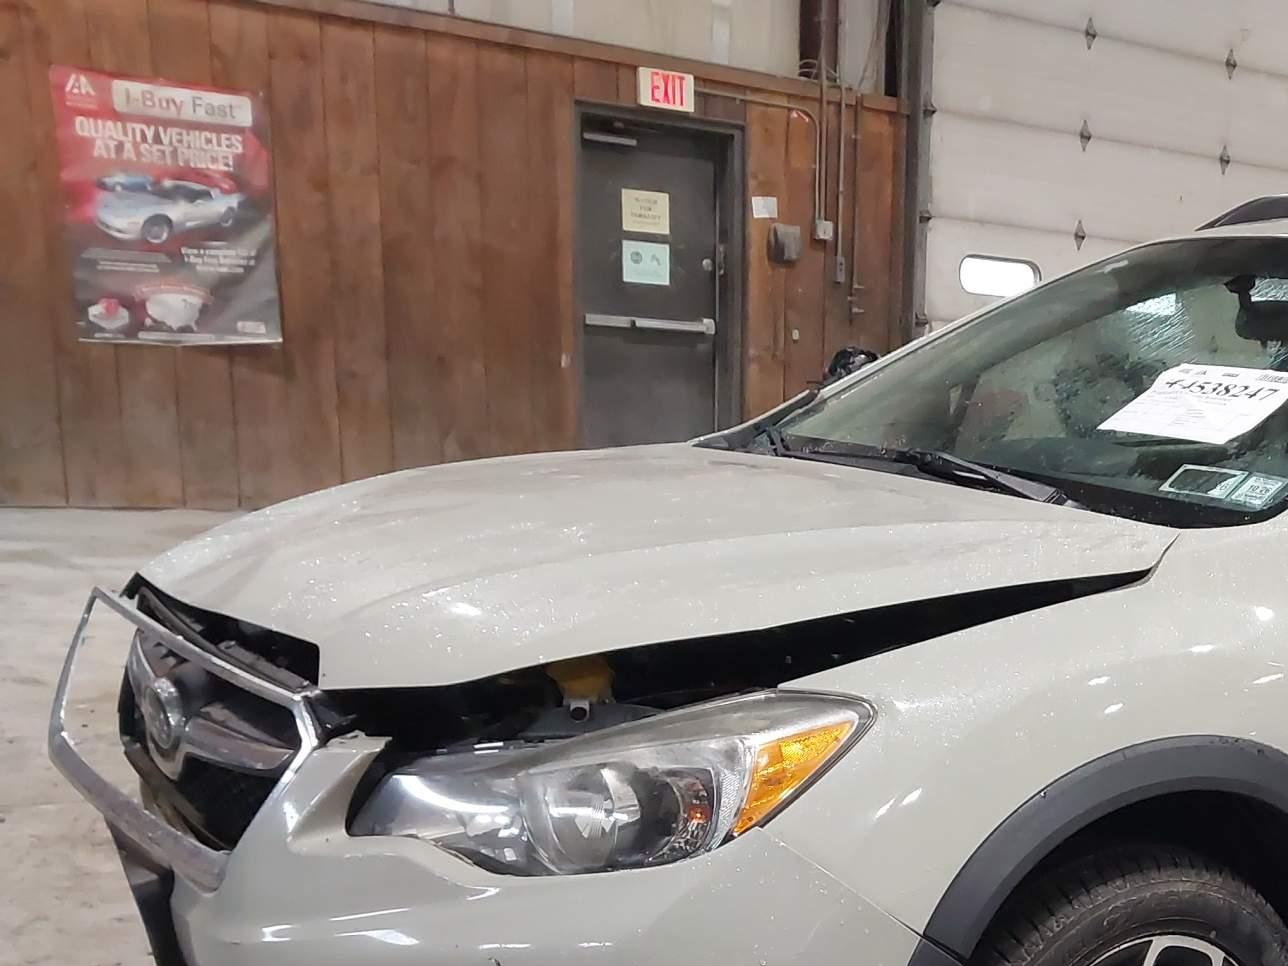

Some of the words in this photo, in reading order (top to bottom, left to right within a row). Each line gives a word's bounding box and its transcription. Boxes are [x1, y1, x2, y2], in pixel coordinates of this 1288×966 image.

[124, 87, 183, 115] I-Buy
[191, 96, 236, 119] Fast
[650, 71, 685, 106] EXIT
[75, 116, 155, 143] QUALITY
[158, 125, 243, 153] VEHICLES
[93, 137, 118, 159] AT
[122, 140, 137, 161] A
[140, 143, 174, 166] SET
[176, 146, 234, 171] PRICE!
